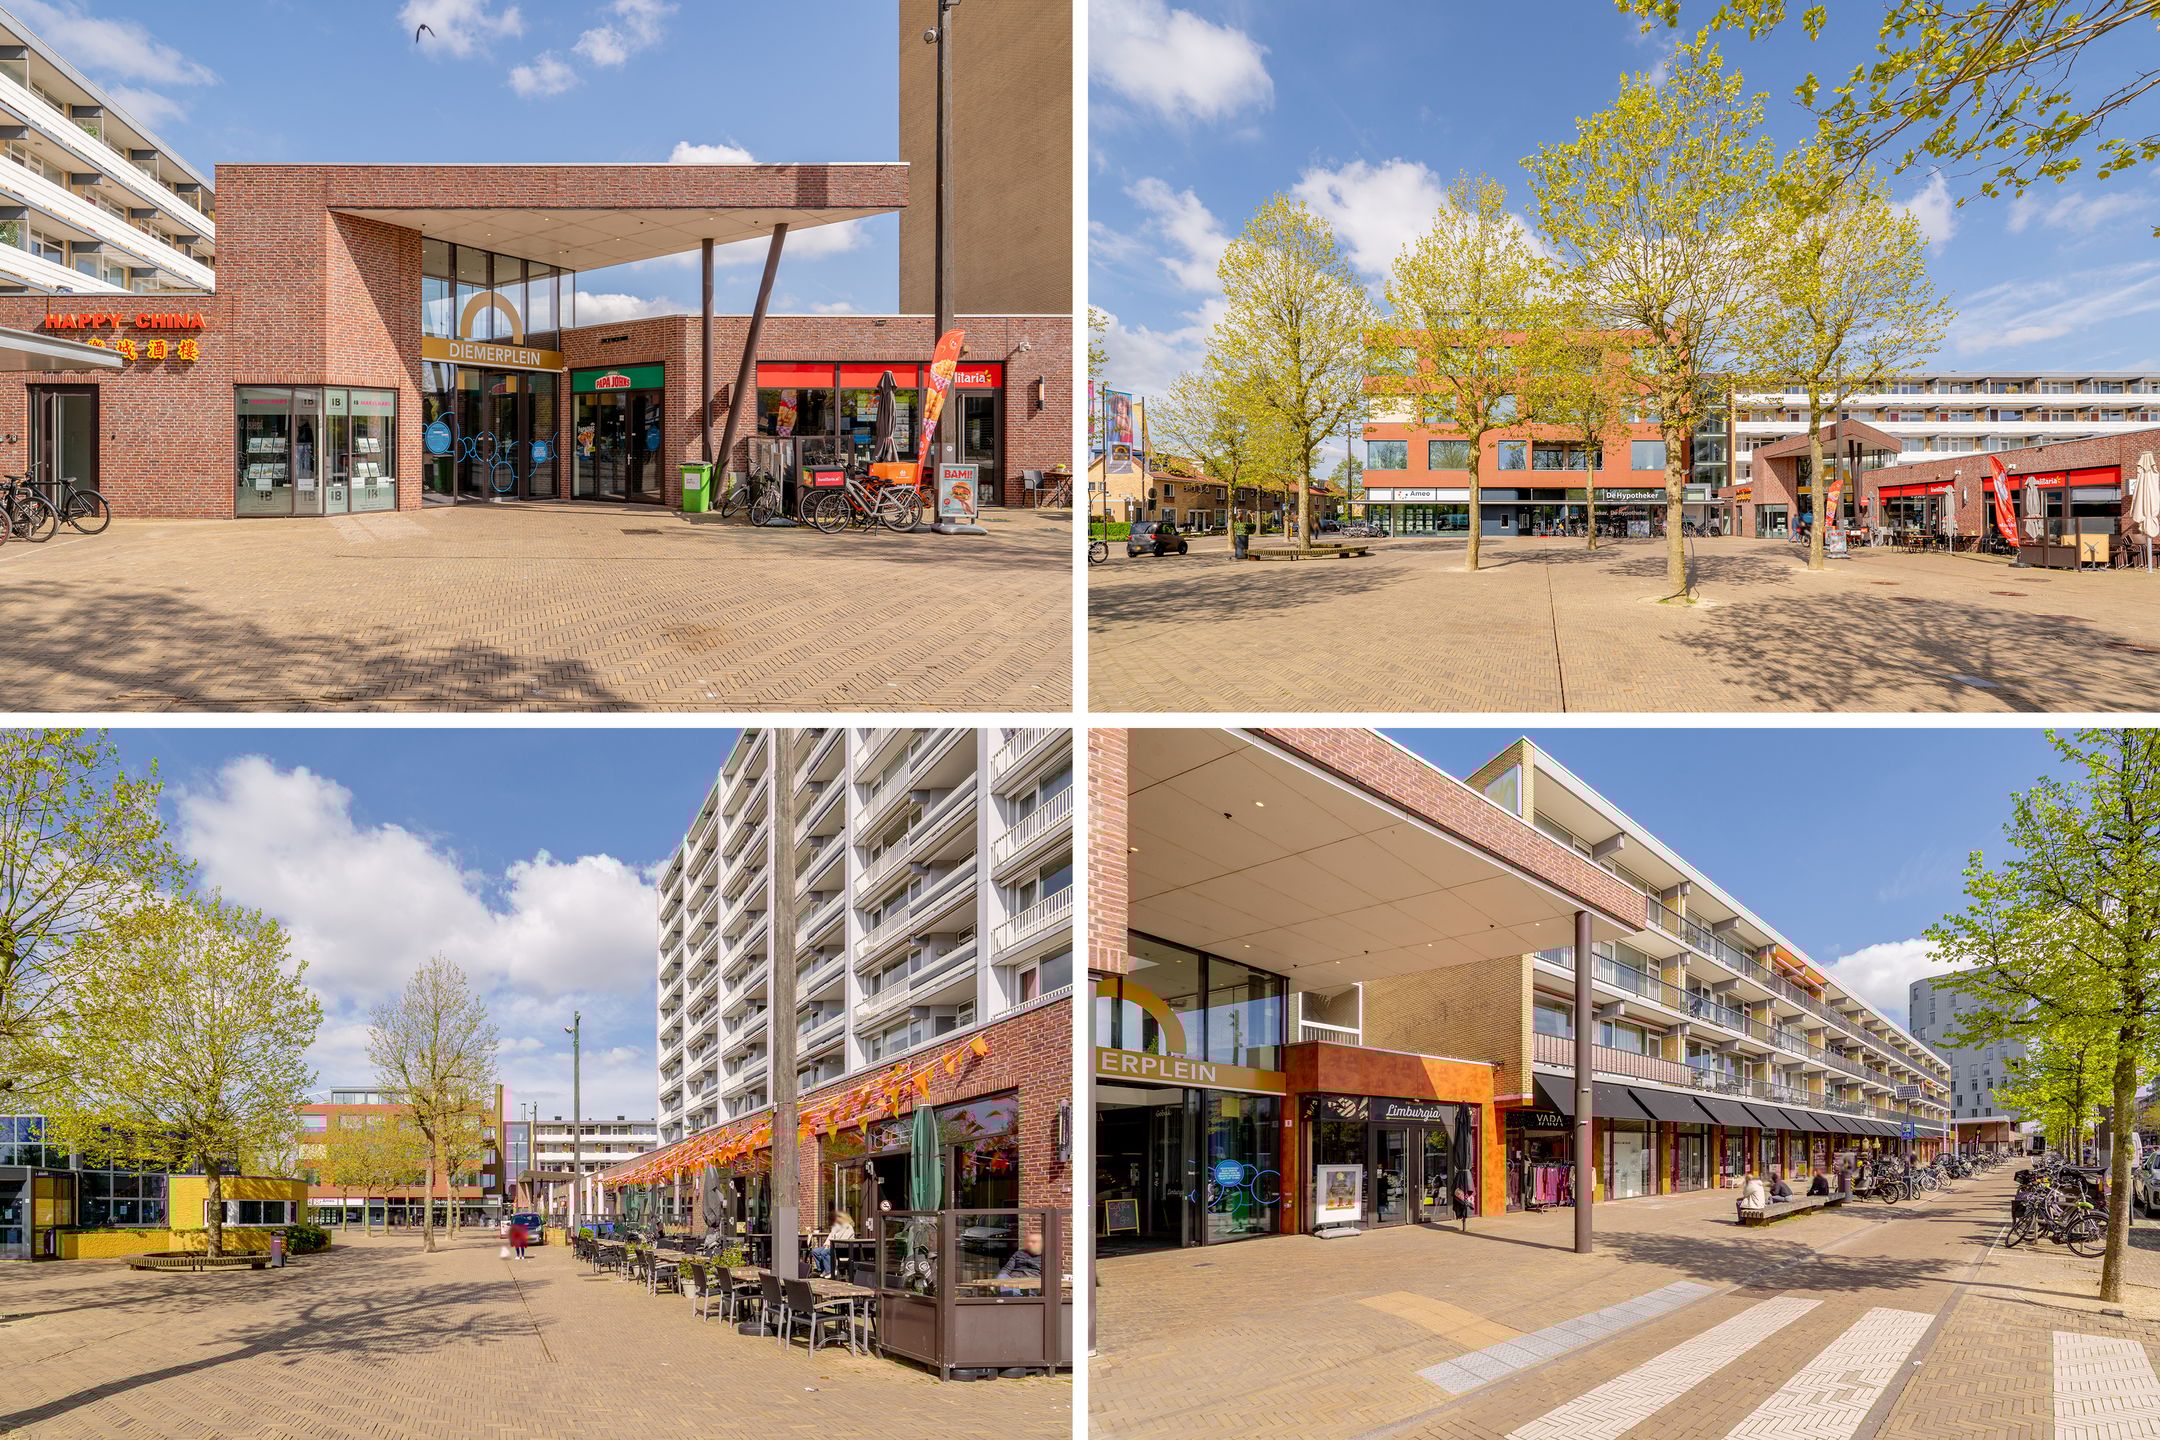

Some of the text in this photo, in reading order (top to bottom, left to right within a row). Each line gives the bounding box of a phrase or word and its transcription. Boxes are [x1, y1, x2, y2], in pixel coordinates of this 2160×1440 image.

[45, 313, 207, 329] HAPPY CHINA
[449, 342, 541, 366] DIEMERPLEIN
[596, 377, 611, 388] PAPA
[954, 371, 986, 383] litaria
[943, 469, 973, 479] BAMI!
[1616, 491, 1659, 500] Hypotheker
[1101, 1051, 1216, 1082] ERPLEIN
[1385, 1103, 1441, 1122] Limburgia
